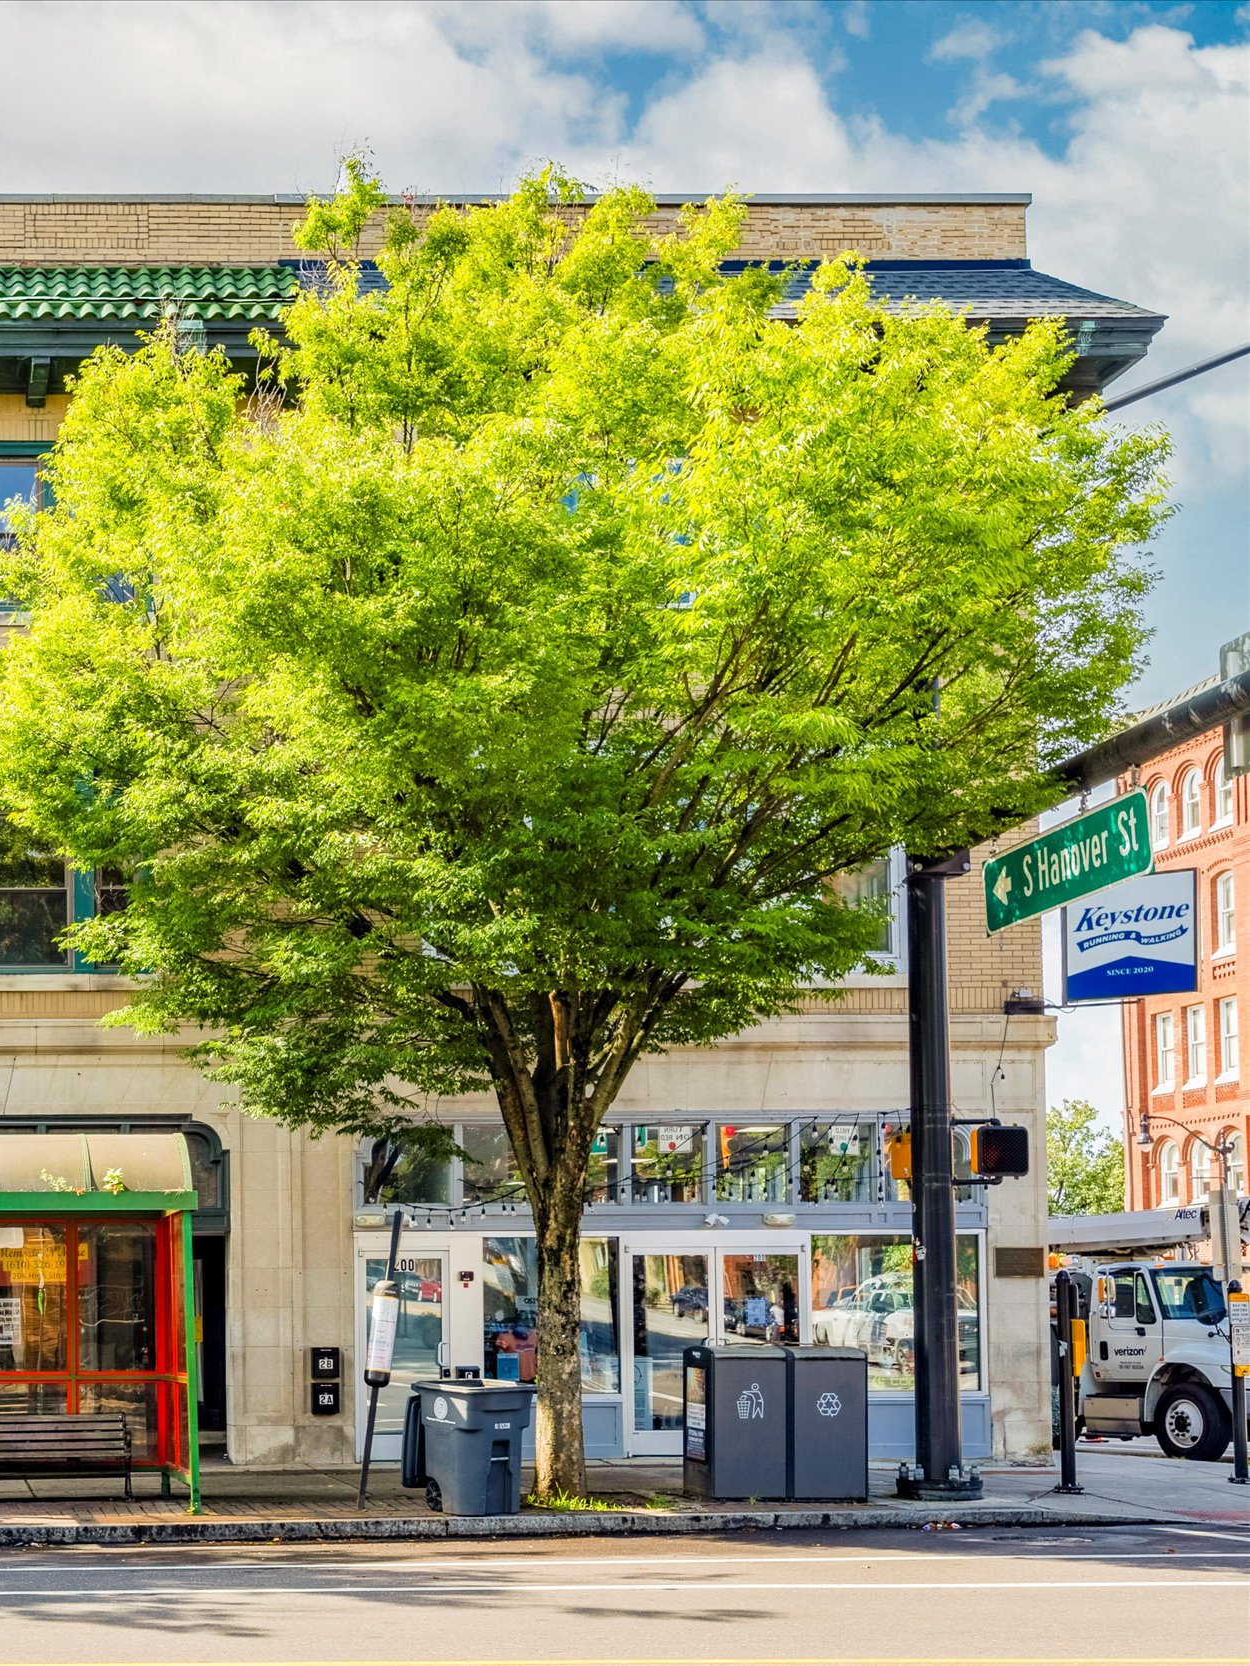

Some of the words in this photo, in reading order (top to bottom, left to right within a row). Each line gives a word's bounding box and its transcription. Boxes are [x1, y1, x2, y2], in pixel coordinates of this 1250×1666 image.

[1023, 854, 1034, 897] S
[1037, 830, 1109, 891] Hanover
[1117, 806, 1139, 857] St
[1073, 903, 1190, 932] Keystone
[1083, 933, 1125, 949] RUNNING
[1140, 929, 1182, 944] WALKING
[1106, 967, 1131, 976] SINCE
[1133, 966, 1154, 974] 2020
[1175, 1209, 1197, 1220] Altec
[1113, 1346, 1144, 1356] verizon
[320, 1360, 332, 1369] 2B
[320, 1395, 333, 1404] 2A
